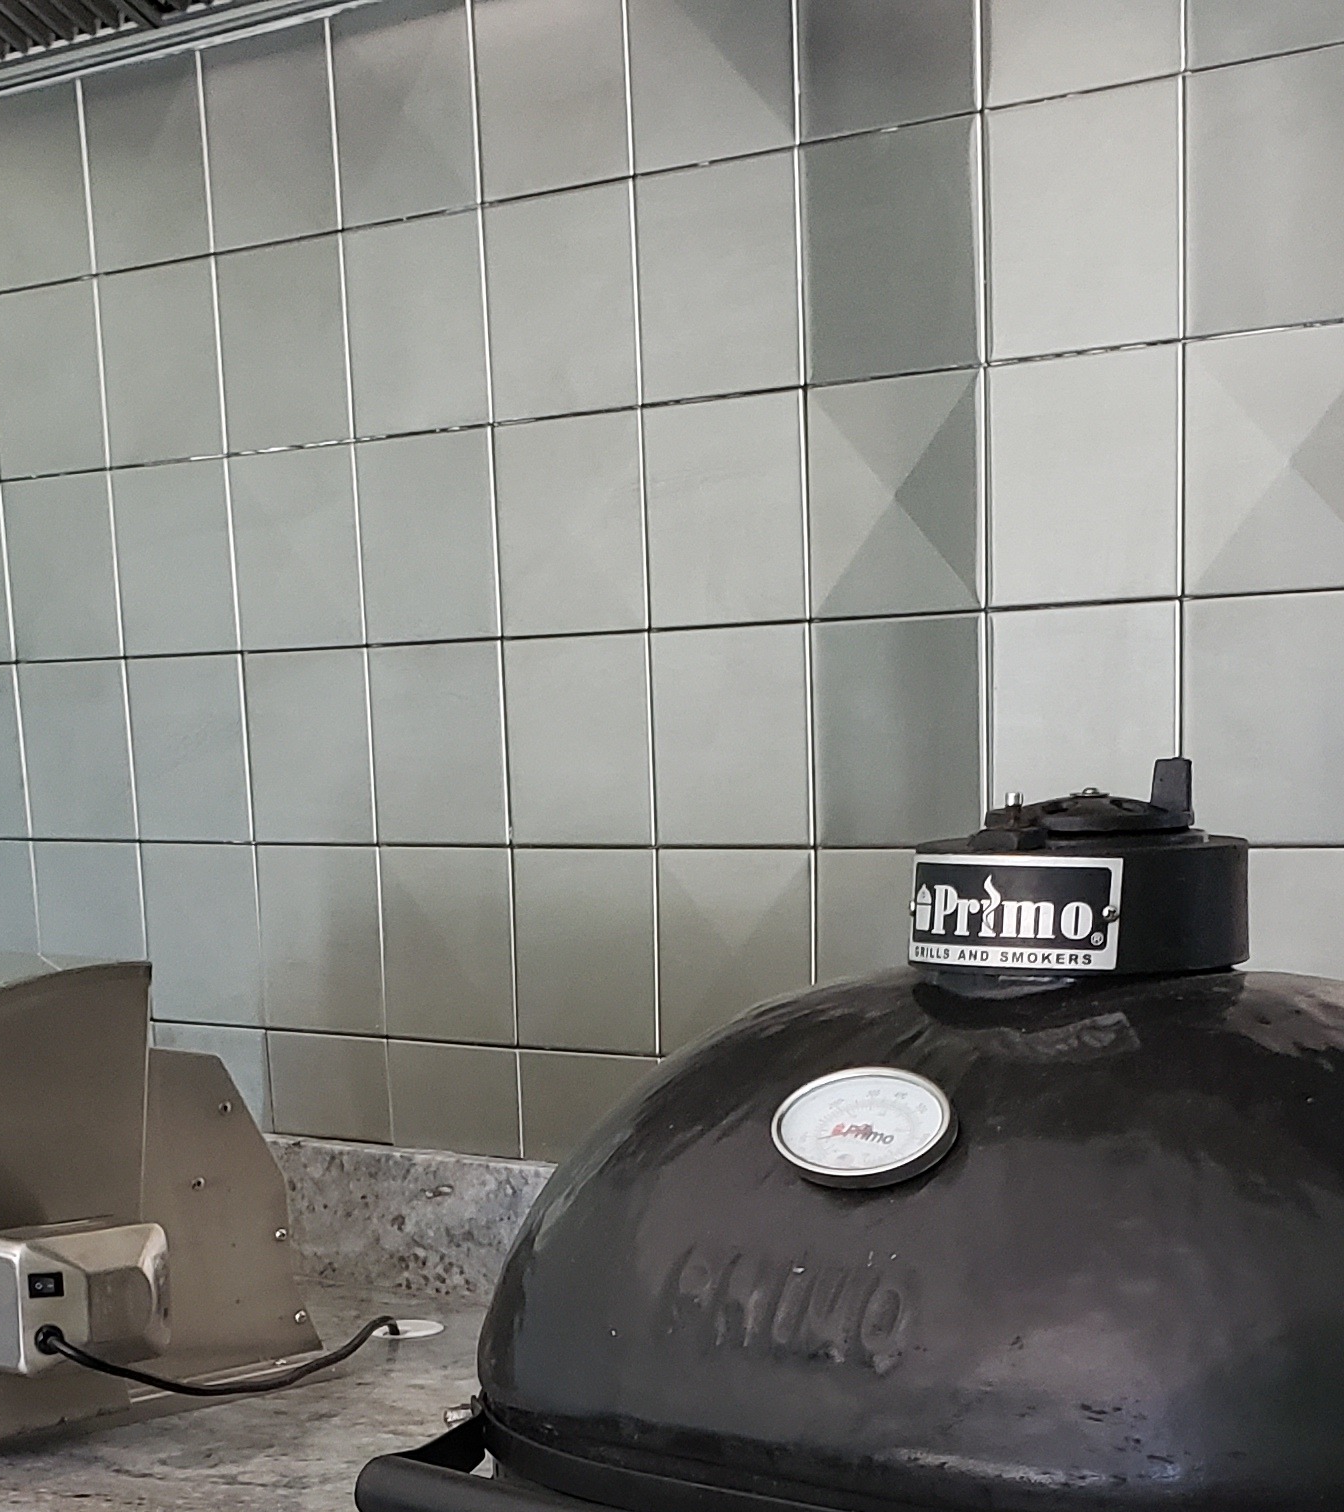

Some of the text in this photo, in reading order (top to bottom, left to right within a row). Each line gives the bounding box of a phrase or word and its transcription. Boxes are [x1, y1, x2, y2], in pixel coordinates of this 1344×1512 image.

[914, 945, 1093, 966] GRILLS AND SMOKERS
